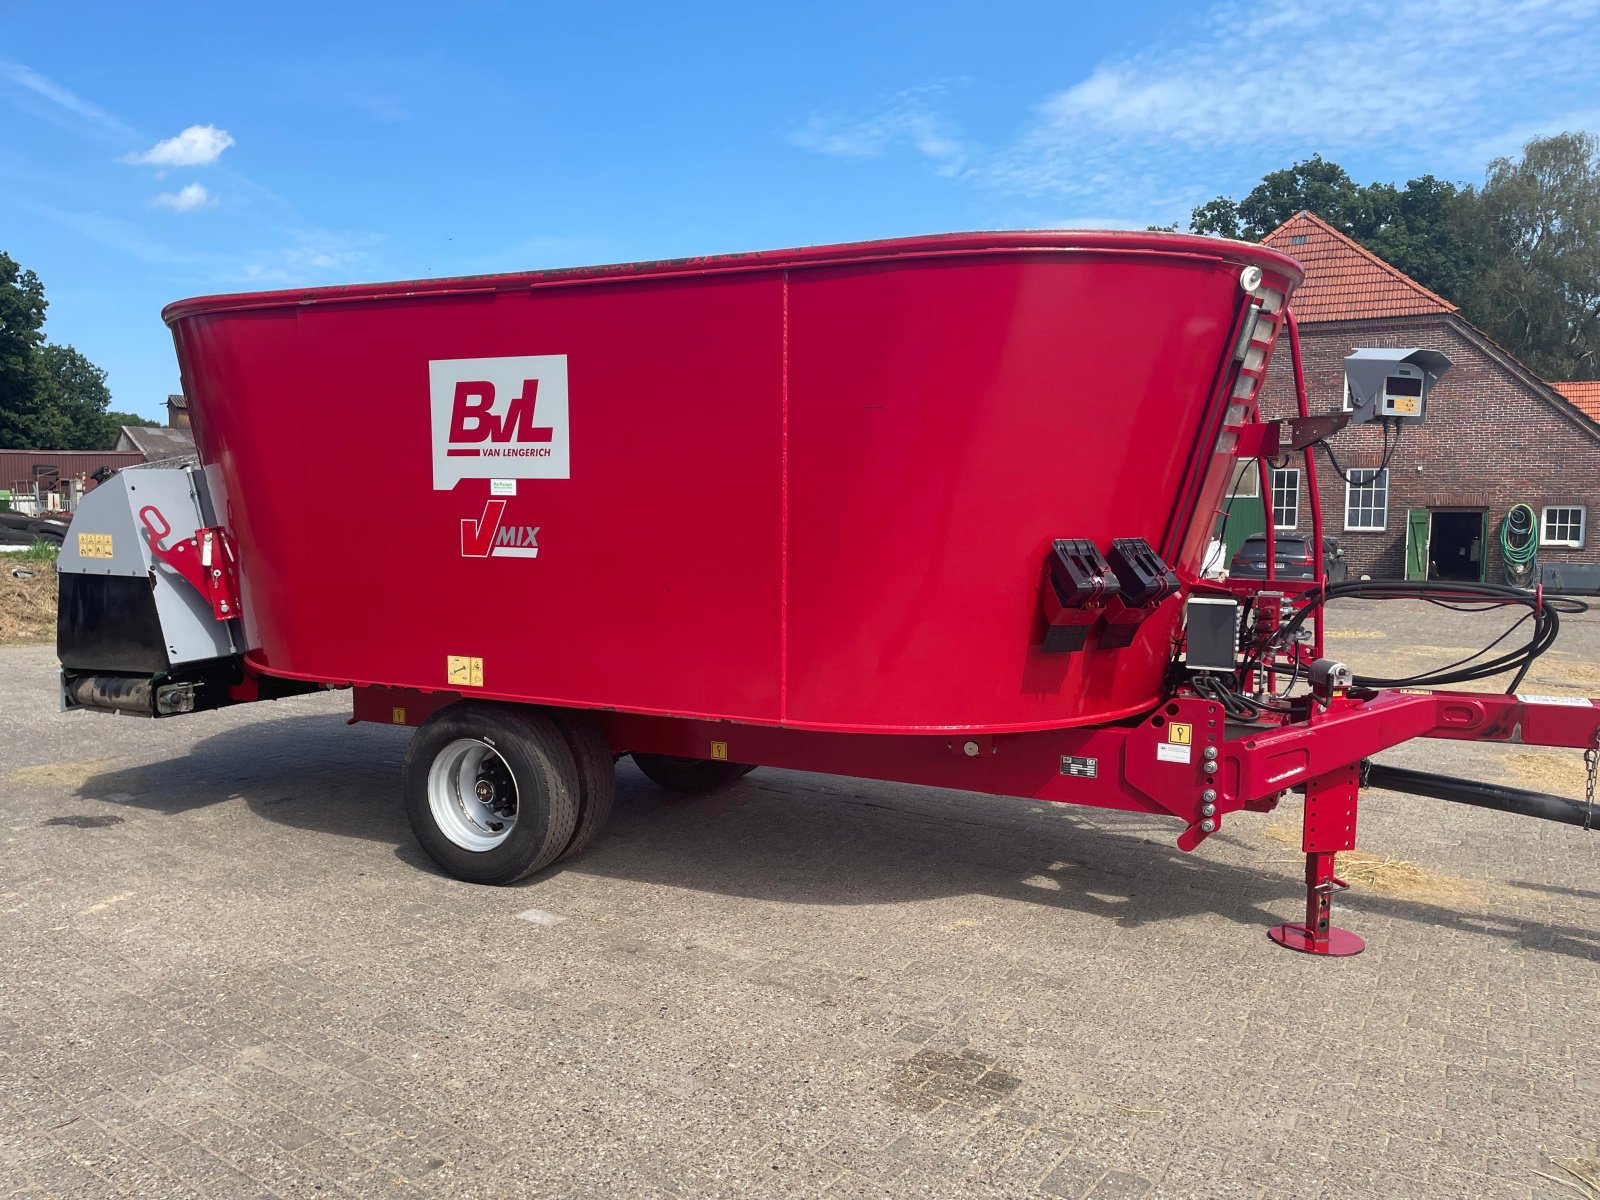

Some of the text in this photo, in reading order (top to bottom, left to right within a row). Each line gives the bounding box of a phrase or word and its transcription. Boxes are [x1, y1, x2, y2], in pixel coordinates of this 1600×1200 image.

[482, 448, 551, 457] VAN LENGERICH
[495, 526, 540, 546] MIX
